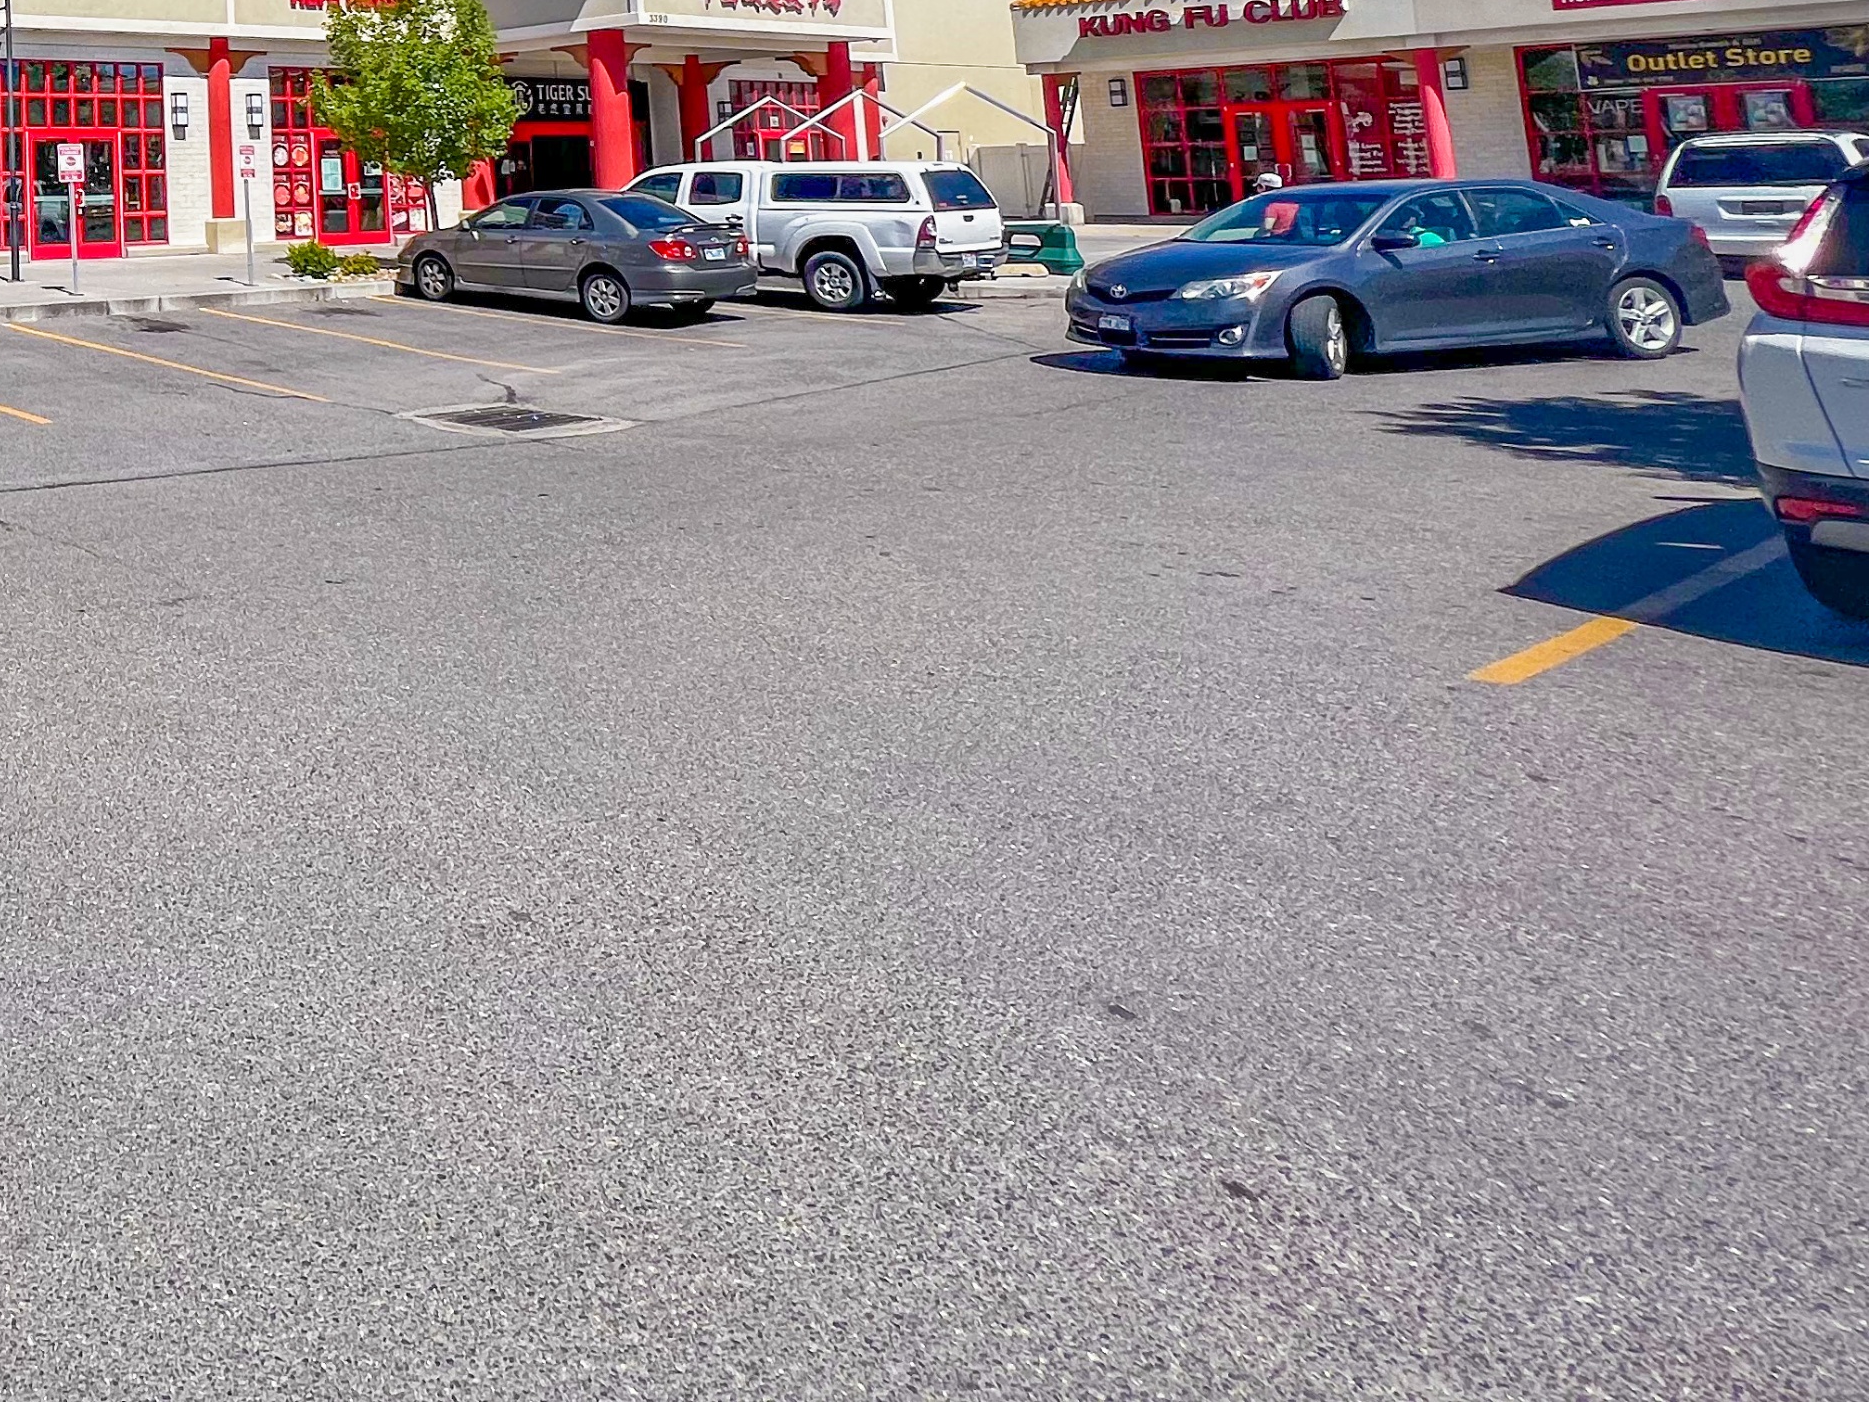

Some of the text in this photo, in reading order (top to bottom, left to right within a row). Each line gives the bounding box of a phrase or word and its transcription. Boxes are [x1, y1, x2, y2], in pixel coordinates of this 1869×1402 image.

[1079, 9, 1171, 38] KUNG
[1184, 3, 1228, 29] FU
[1626, 48, 1812, 73] Outlet Store
[536, 84, 575, 101] TIGER
[1587, 99, 1644, 114] VAPE
